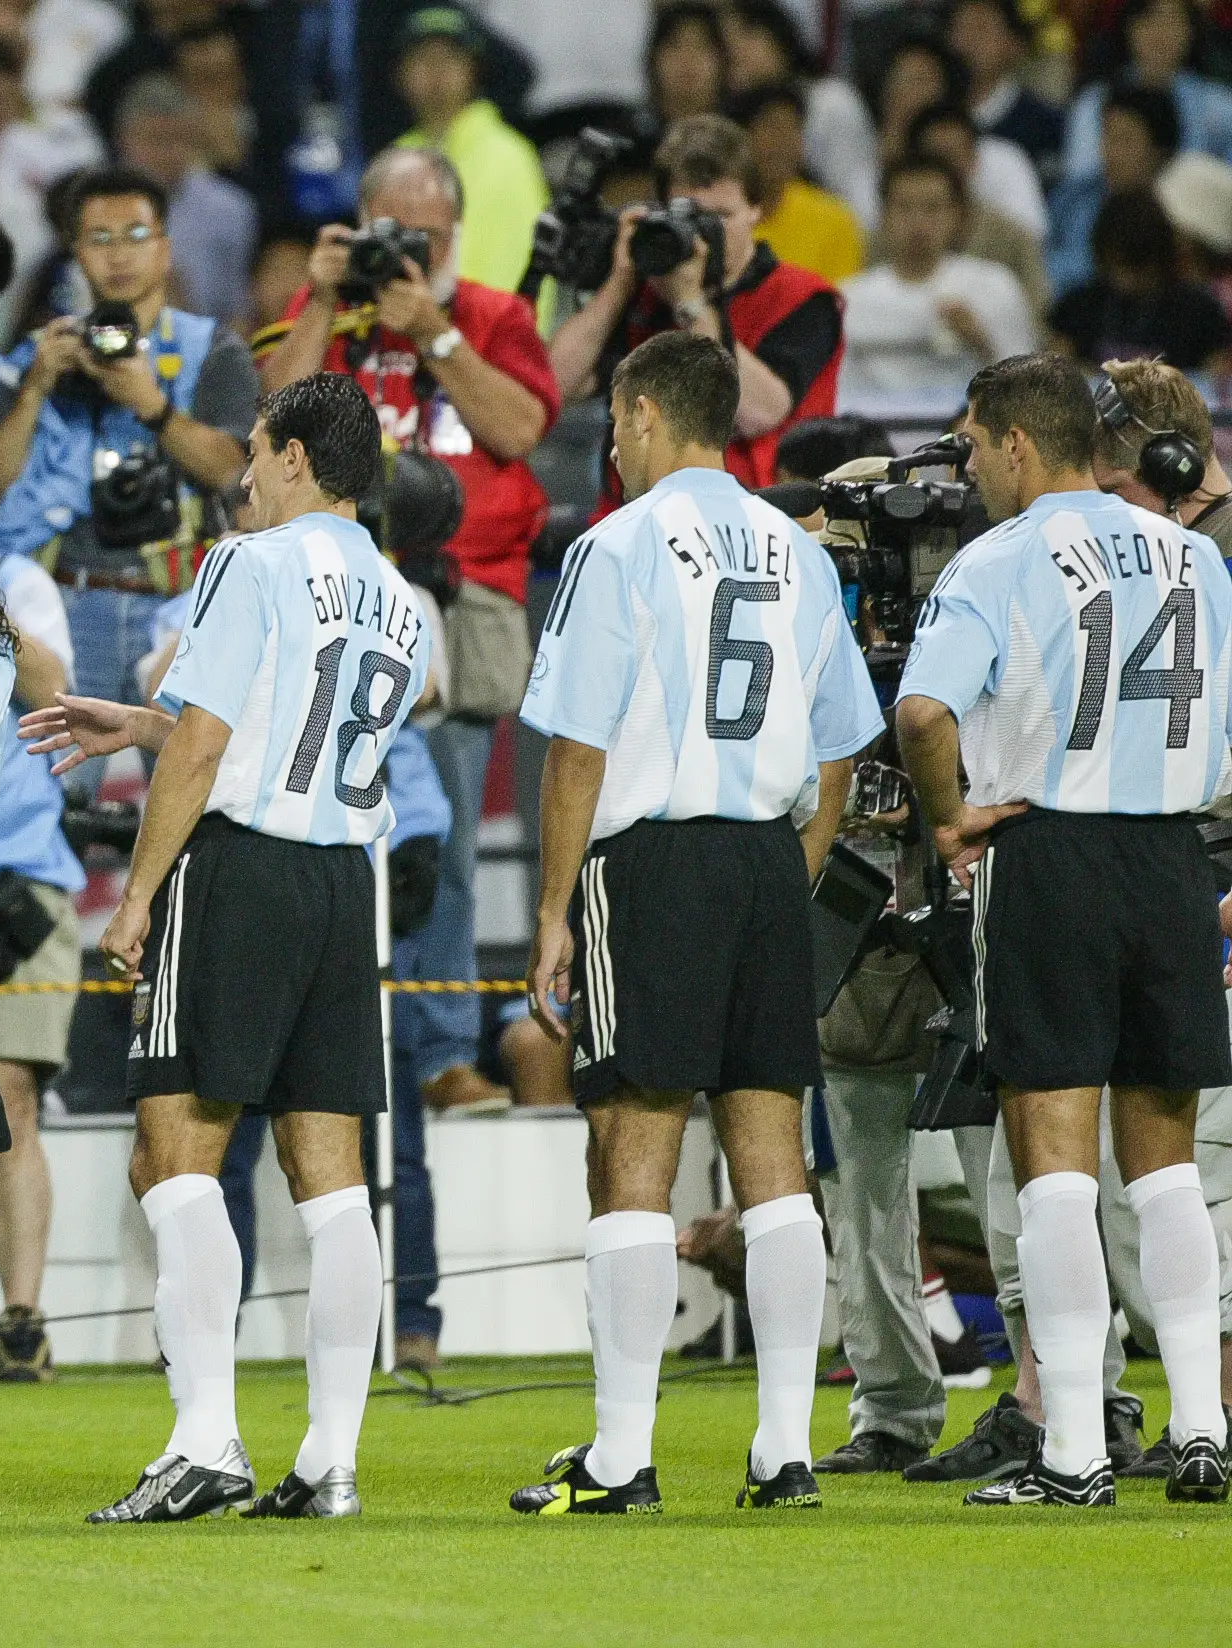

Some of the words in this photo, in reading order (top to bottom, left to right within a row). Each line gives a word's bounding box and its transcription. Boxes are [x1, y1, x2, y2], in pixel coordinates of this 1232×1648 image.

[1051, 533, 1193, 592] SIMEONE
[285, 636, 412, 810] 18
[705, 577, 781, 741] 6
[1066, 587, 1205, 750] 14
